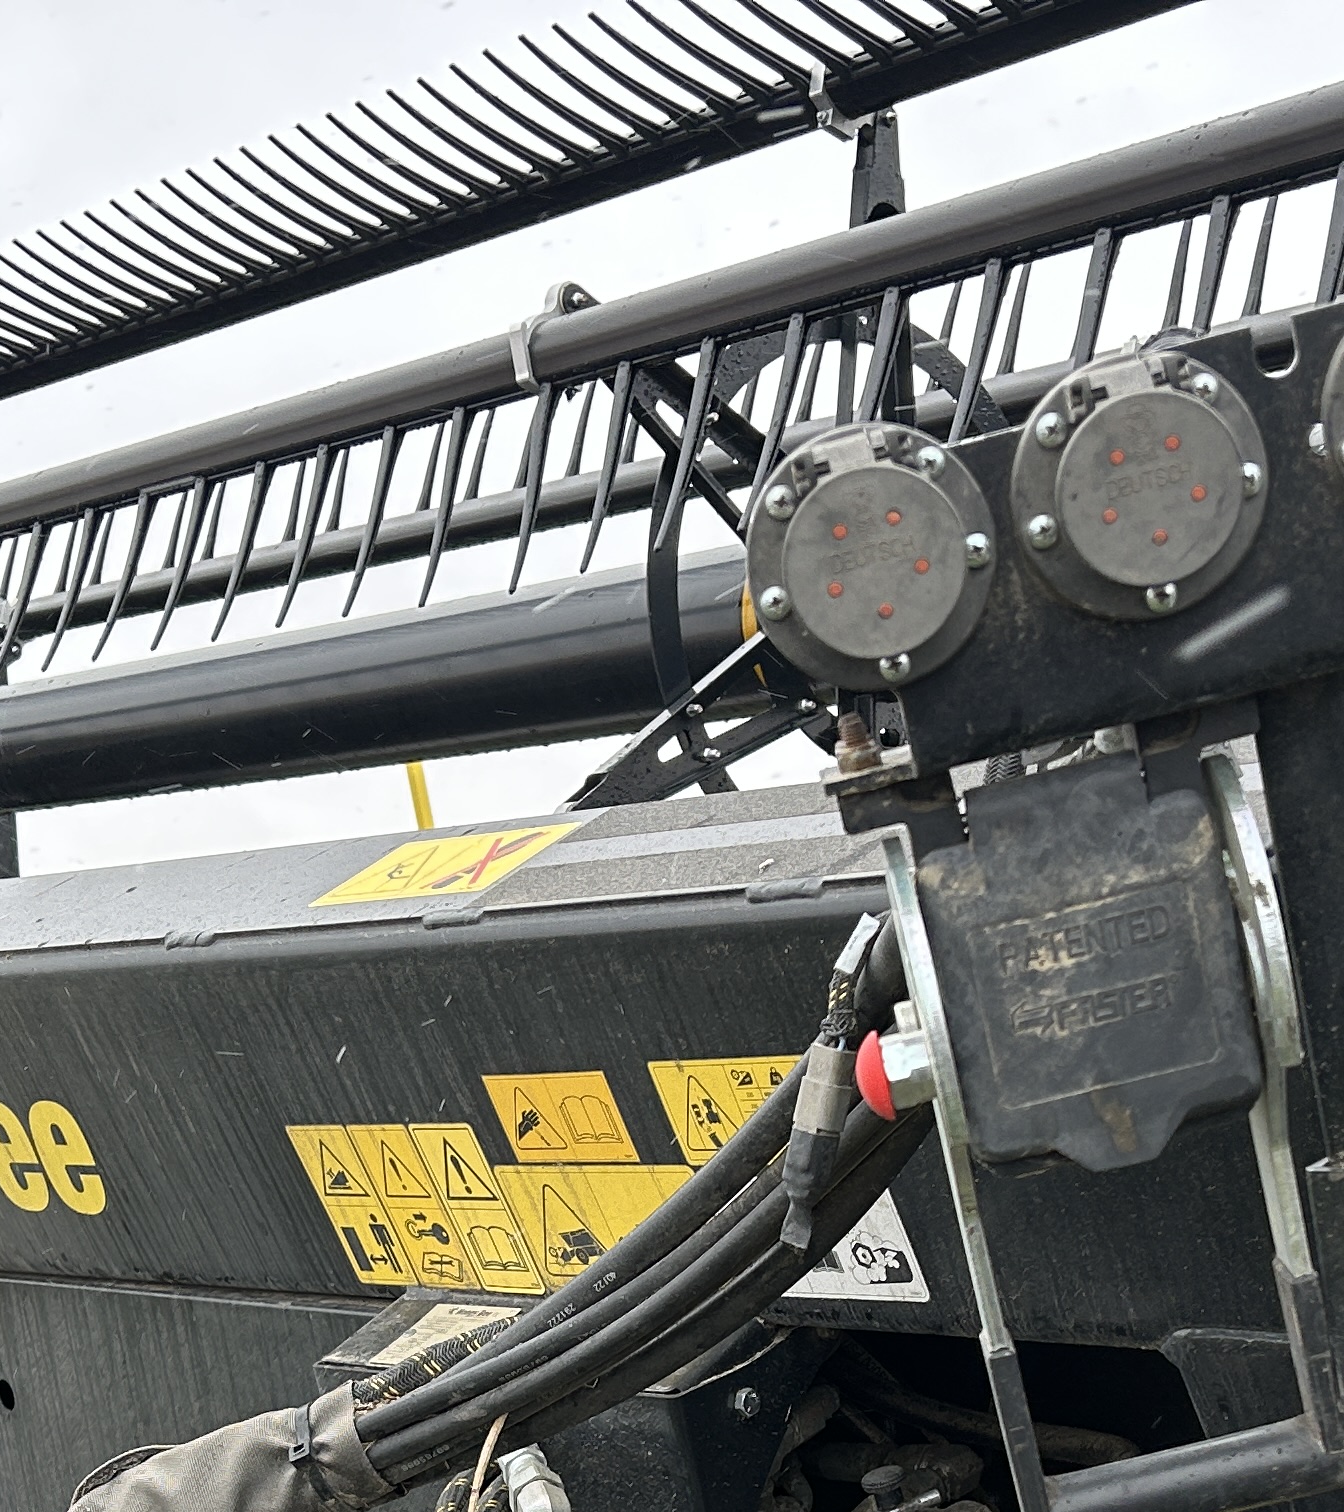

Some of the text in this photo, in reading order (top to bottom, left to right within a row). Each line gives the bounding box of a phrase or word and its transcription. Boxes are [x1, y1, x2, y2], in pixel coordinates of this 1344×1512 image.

[1106, 461, 1194, 503] DEUTSCH
[827, 534, 917, 576] DEUTSCH
[998, 904, 1170, 974] PATENTED
